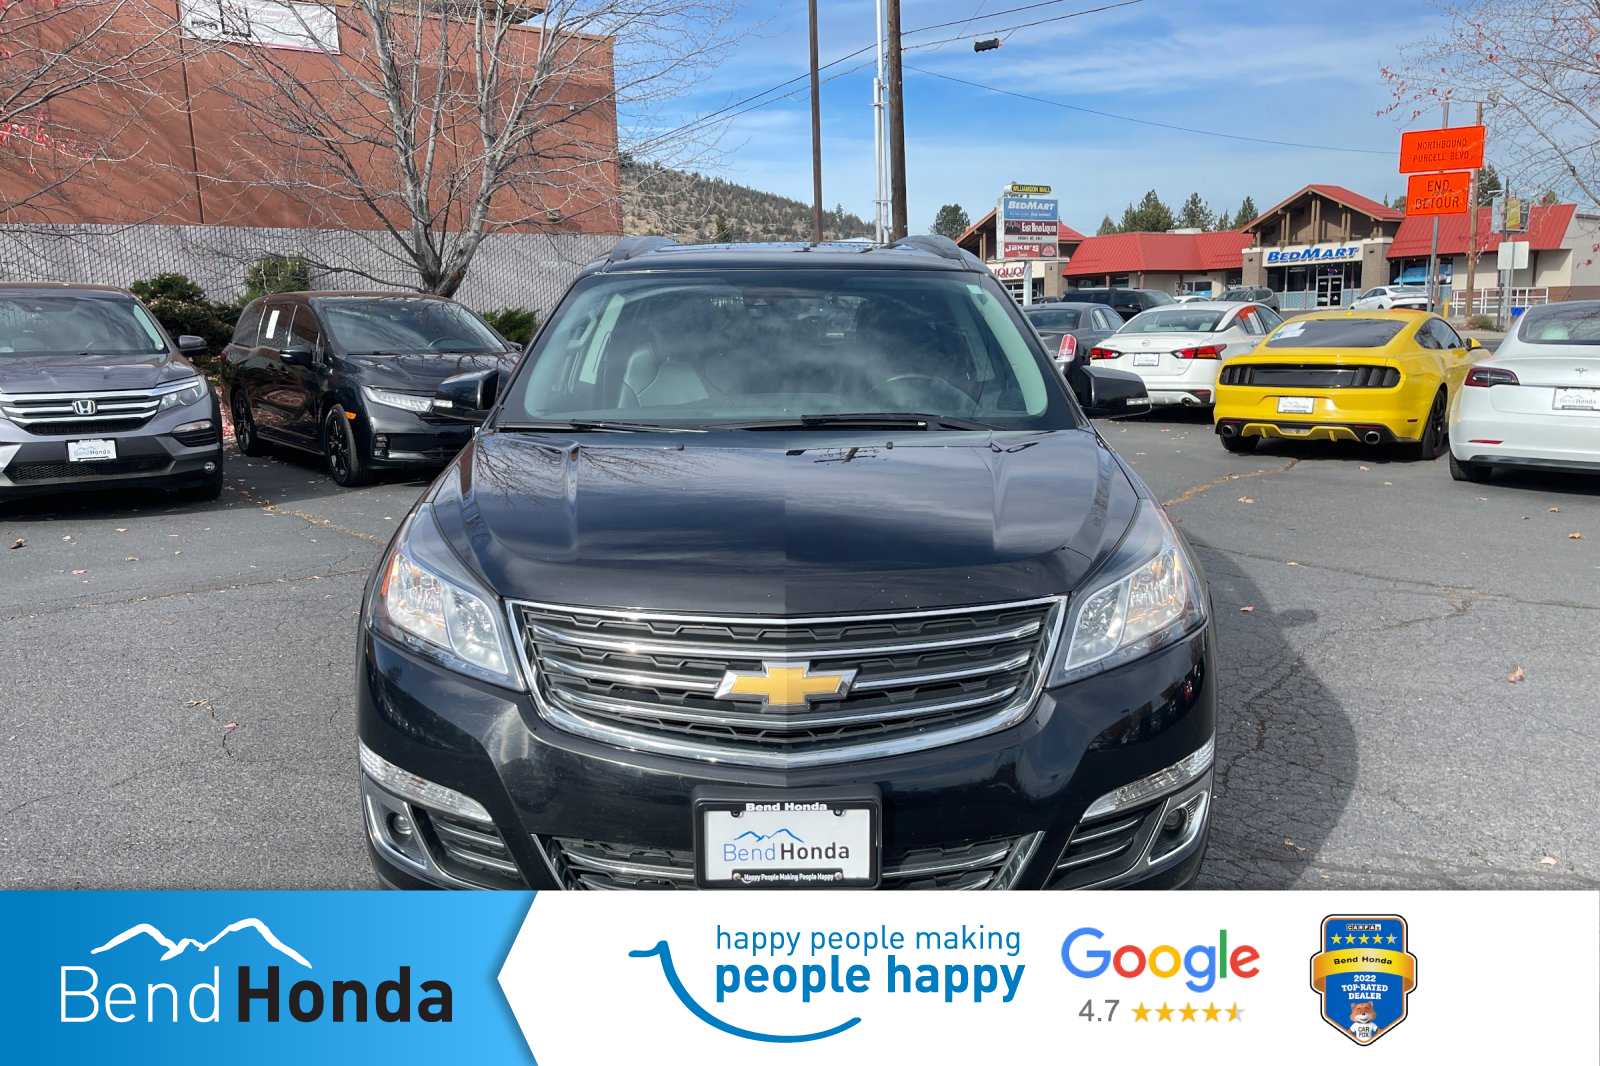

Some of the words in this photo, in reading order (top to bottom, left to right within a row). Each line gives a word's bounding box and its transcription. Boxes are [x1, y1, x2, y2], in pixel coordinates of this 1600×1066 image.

[1416, 137, 1467, 150] NORTHBOUND
[1412, 152, 1447, 163] PURCELL
[1427, 179, 1450, 192] END
[1415, 196, 1459, 209] DETOUR
[1267, 246, 1360, 263] BEDMART
[745, 802, 781, 811] Bend
[785, 802, 828, 811] Honda
[723, 842, 776, 862] Bend
[780, 842, 850, 861] Honda
[743, 873, 761, 882] Happy
[761, 873, 779, 881] People
[780, 873, 799, 882] Making
[799, 873, 816, 881] People
[817, 873, 834, 881] Happy
